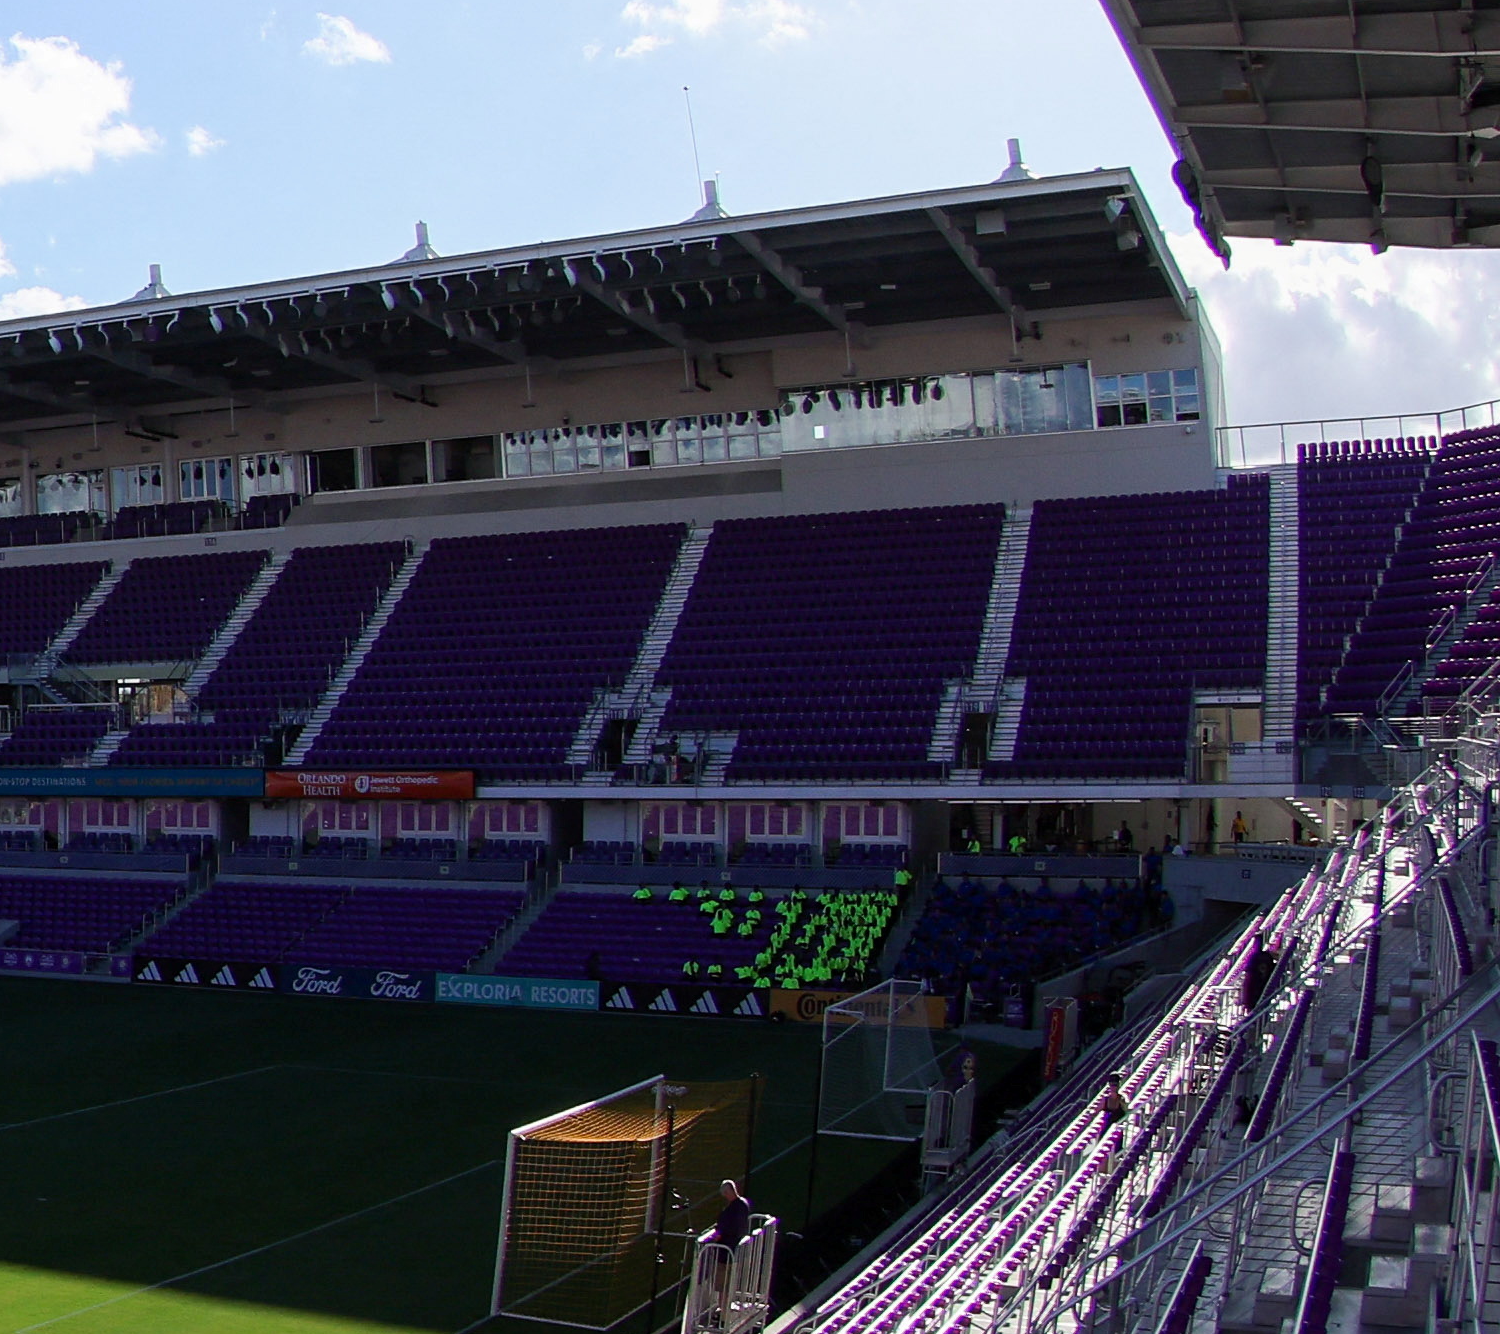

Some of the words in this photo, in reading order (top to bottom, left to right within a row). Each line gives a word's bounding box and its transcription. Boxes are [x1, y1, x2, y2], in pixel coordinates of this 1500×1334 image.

[297, 772, 346, 784] ORLANDO
[303, 785, 341, 796] HEALTH
[292, 966, 342, 996] Ford
[370, 969, 422, 1000] Ford
[530, 985, 596, 1005] RESORTS
